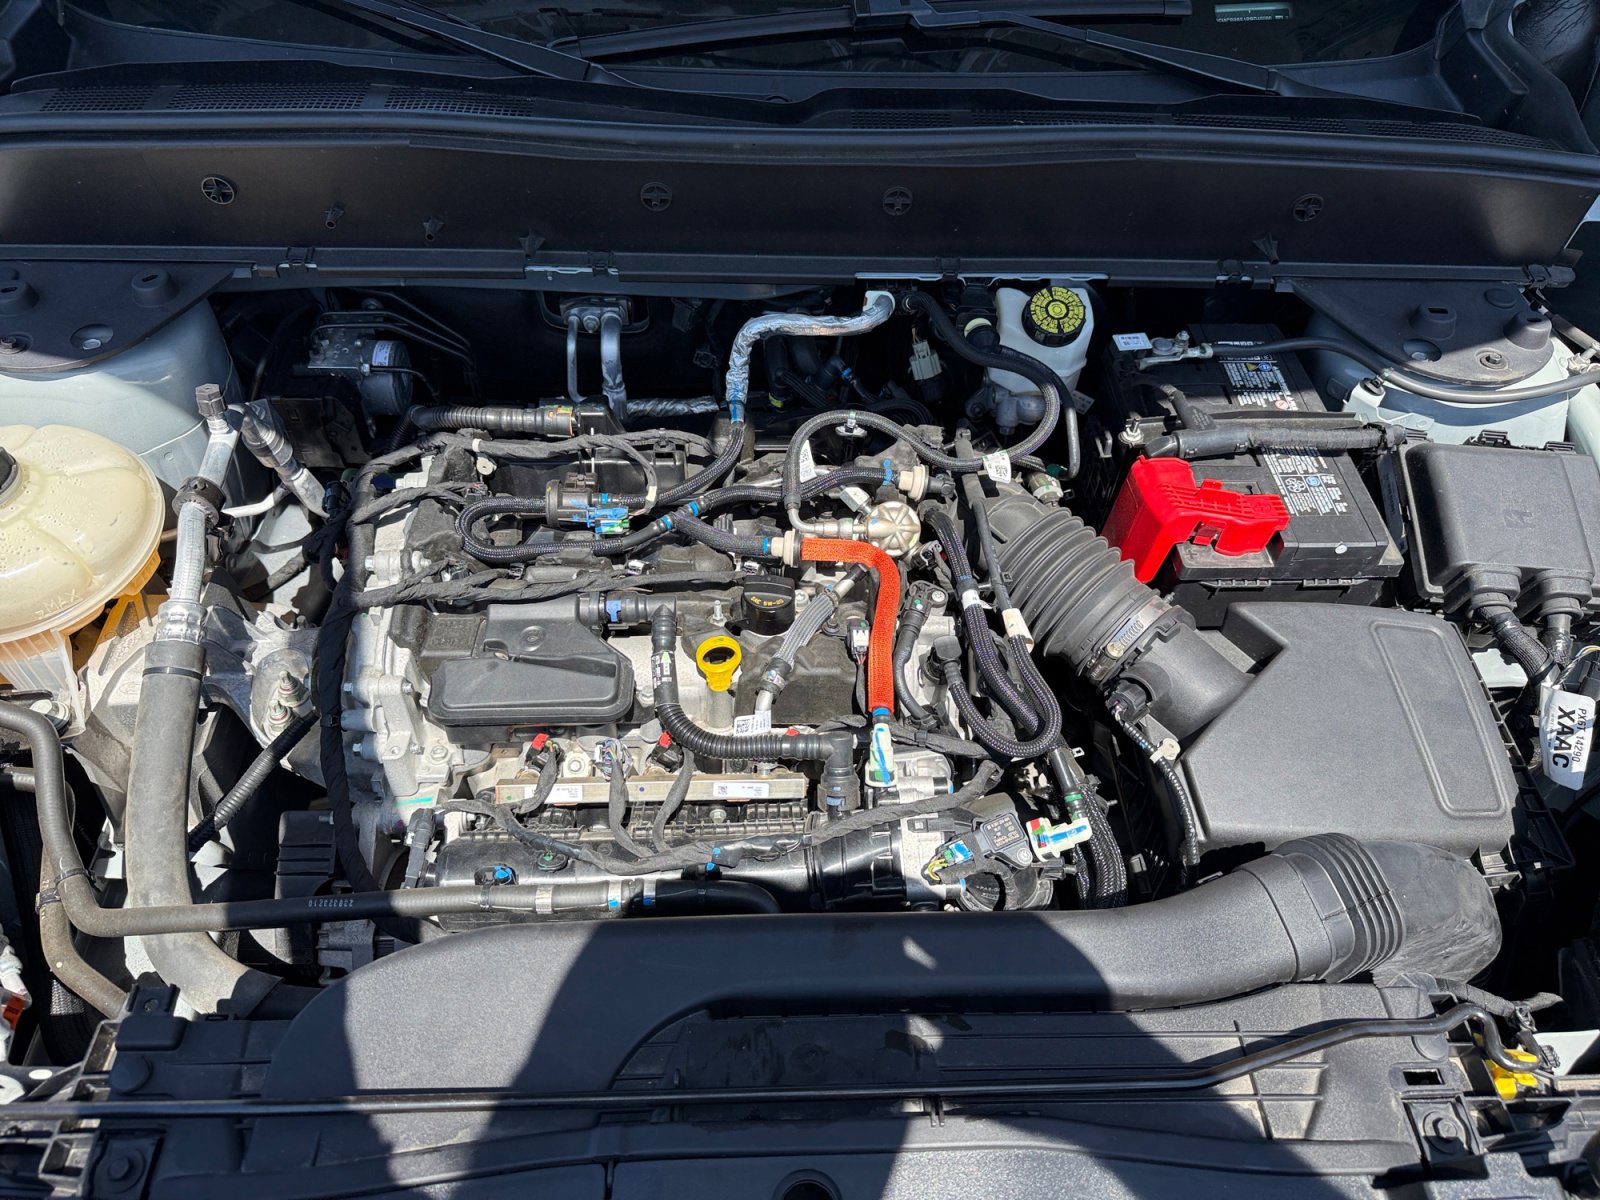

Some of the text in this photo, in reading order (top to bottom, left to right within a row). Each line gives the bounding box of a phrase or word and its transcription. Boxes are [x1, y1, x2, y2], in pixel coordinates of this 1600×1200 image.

[1552, 705, 1576, 769] XAAC
[1571, 708, 1588, 763] PX6T 14290
